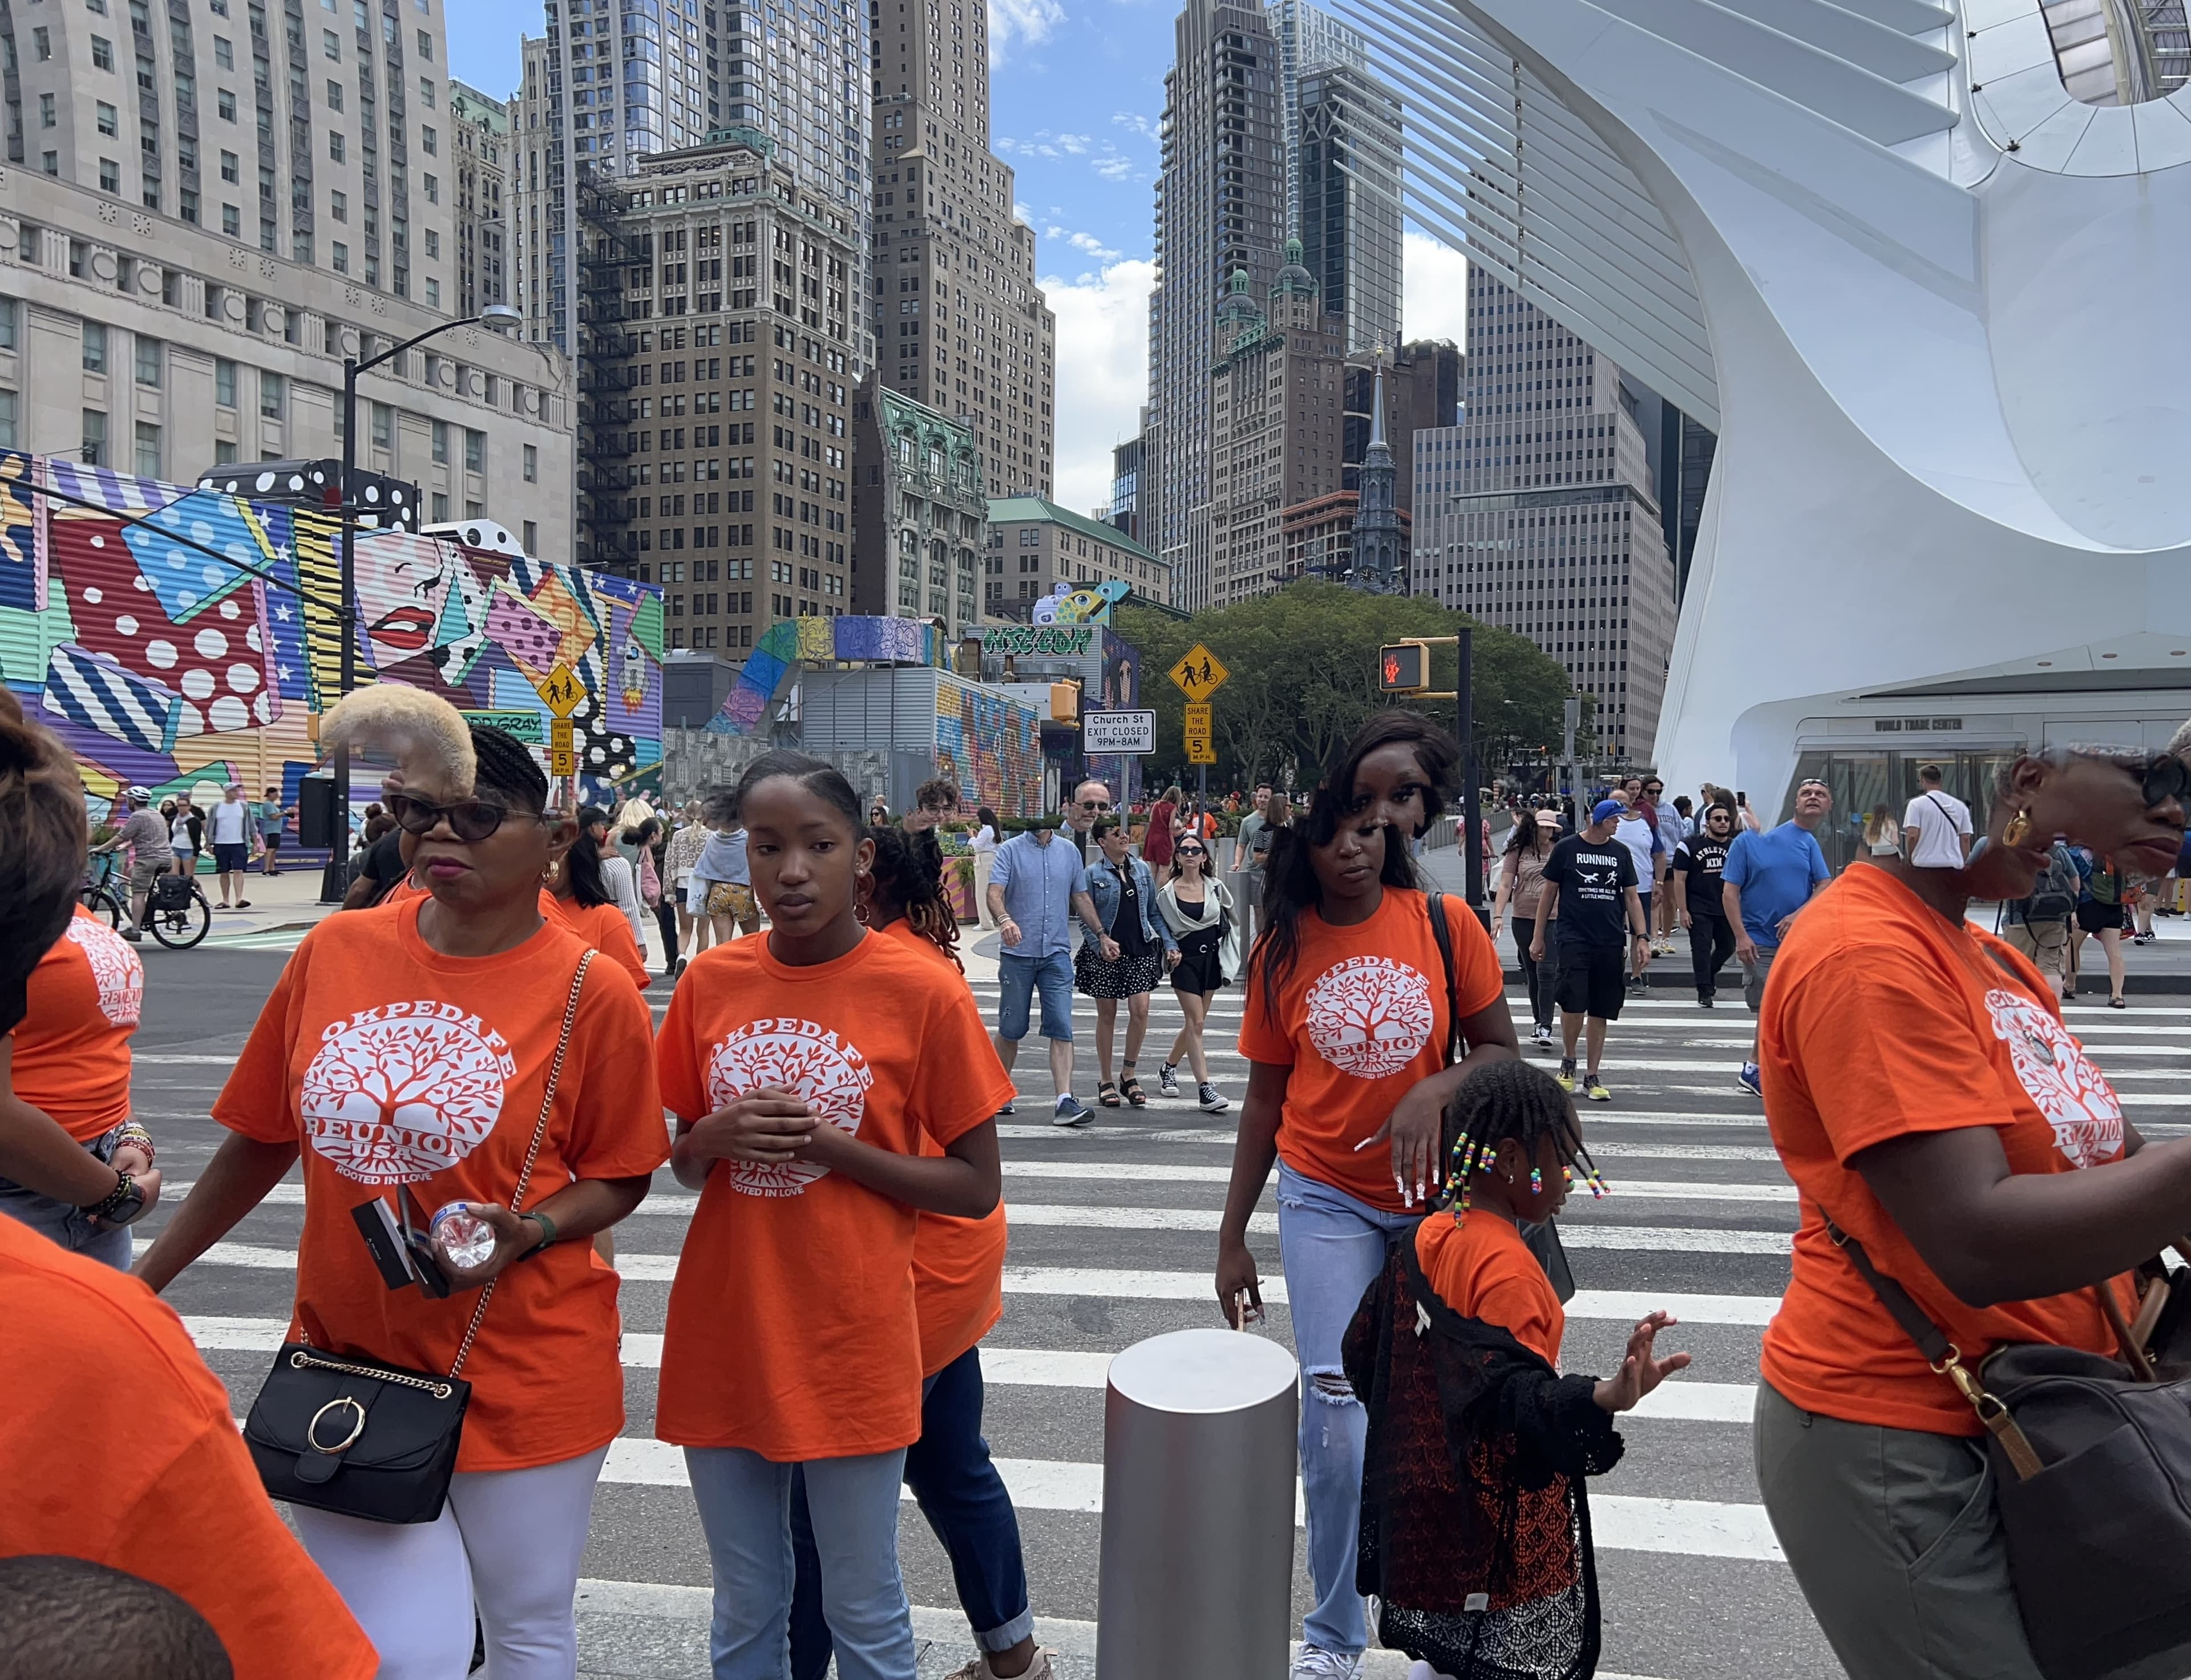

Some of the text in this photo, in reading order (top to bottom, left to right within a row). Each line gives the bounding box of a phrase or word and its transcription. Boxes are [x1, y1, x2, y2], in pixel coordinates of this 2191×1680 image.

[497, 717, 540, 731] GRAY
[1093, 715, 1143, 724] Church St
[1088, 727, 1149, 736] EXIT CLOSED
[1097, 738, 1140, 746] 9PM-8AM
[1192, 740, 1203, 753] 5
[558, 754, 567, 766] 5
[1576, 853, 1618, 867] RUNNING
[1707, 857, 1723, 868] MXM
[1318, 1035, 1428, 1059] REUNION
[1355, 1052, 1392, 1063] USA
[1348, 1070, 1376, 1079] ROOTED
[1386, 1064, 1406, 1076] LOVE
[304, 1118, 478, 1158] REUNION
[350, 1143, 413, 1161] USA
[335, 1164, 432, 1185] ROOTED IN LOVE
[730, 1179, 762, 1196] OOTED
[779, 1185, 805, 1197] LOVE
